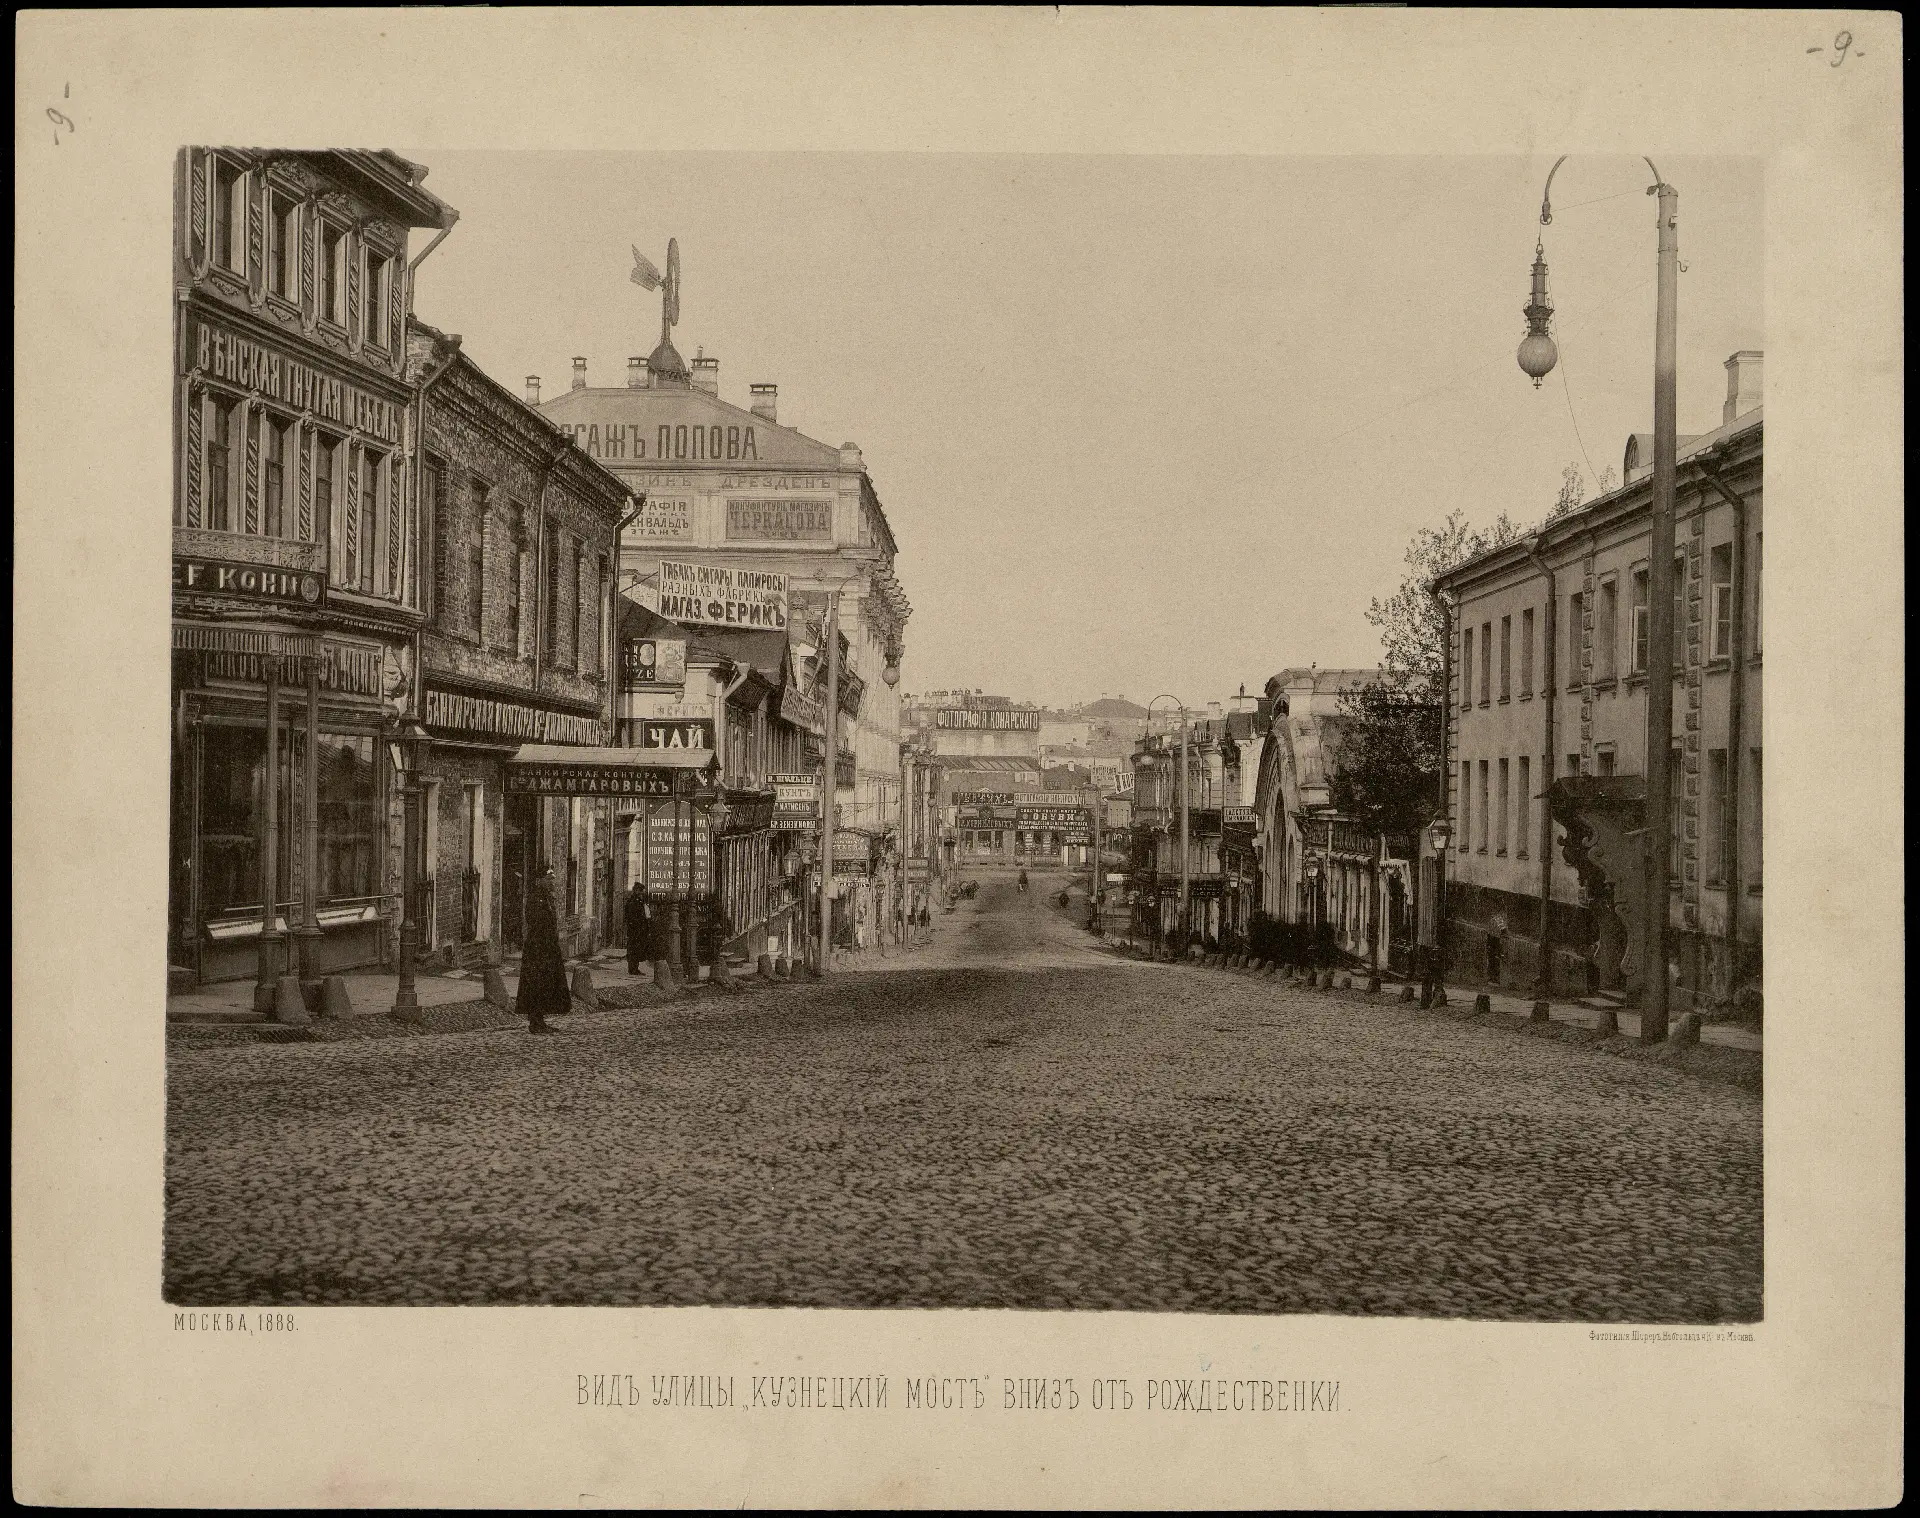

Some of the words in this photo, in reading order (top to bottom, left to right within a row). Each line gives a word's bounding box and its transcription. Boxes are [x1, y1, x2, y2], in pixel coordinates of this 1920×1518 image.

[250, 201, 262, 270] ВѢНА
[303, 226, 313, 301] ПАРИЖЪ
[350, 259, 359, 319] РИМЪ
[197, 322, 280, 399] ВѢНСКАЯ
[283, 357, 341, 422] ГНУТАЯ
[343, 383, 399, 443] МЕБЕЛЬ
[657, 424, 764, 460] ПОПОВА.
[188, 405, 200, 529] АМСТЕРДАМЪ
[721, 476, 831, 490] ДРЕЗДЕНЪ
[246, 437, 258, 534] НЕАПОЛЬ
[347, 470, 357, 557] МАДРИДЪ
[218, 567, 297, 596] KOHN
[661, 561, 696, 582] ТАБАКЪ
[697, 566, 733, 587] СИГАРЫ
[737, 571, 786, 592] ПАПИРОСЫ
[661, 581, 712, 598] РАЗНЫХЪ
[716, 587, 765, 603] ФАБРИКЪ
[660, 594, 705, 620] МАГАЗ.
[707, 600, 786, 628] ФЕРИКЪ
[426, 690, 494, 733] БАНКИРСКАЯ
[495, 703, 534, 738] КОНТОРА
[937, 710, 987, 729] ФОТОГРАФІЯ
[990, 711, 1038, 729] КОНАРСКАГО
[649, 724, 706, 749] ЧАЙ
[520, 768, 599, 778] БАНКИРСКАЯ
[526, 776, 669, 793] ДЖАМГАРОВЫХЪ
[779, 820, 816, 829] ЗЕНЗИНОВЫ
[1033, 812, 1075, 821] ОБУВИ
